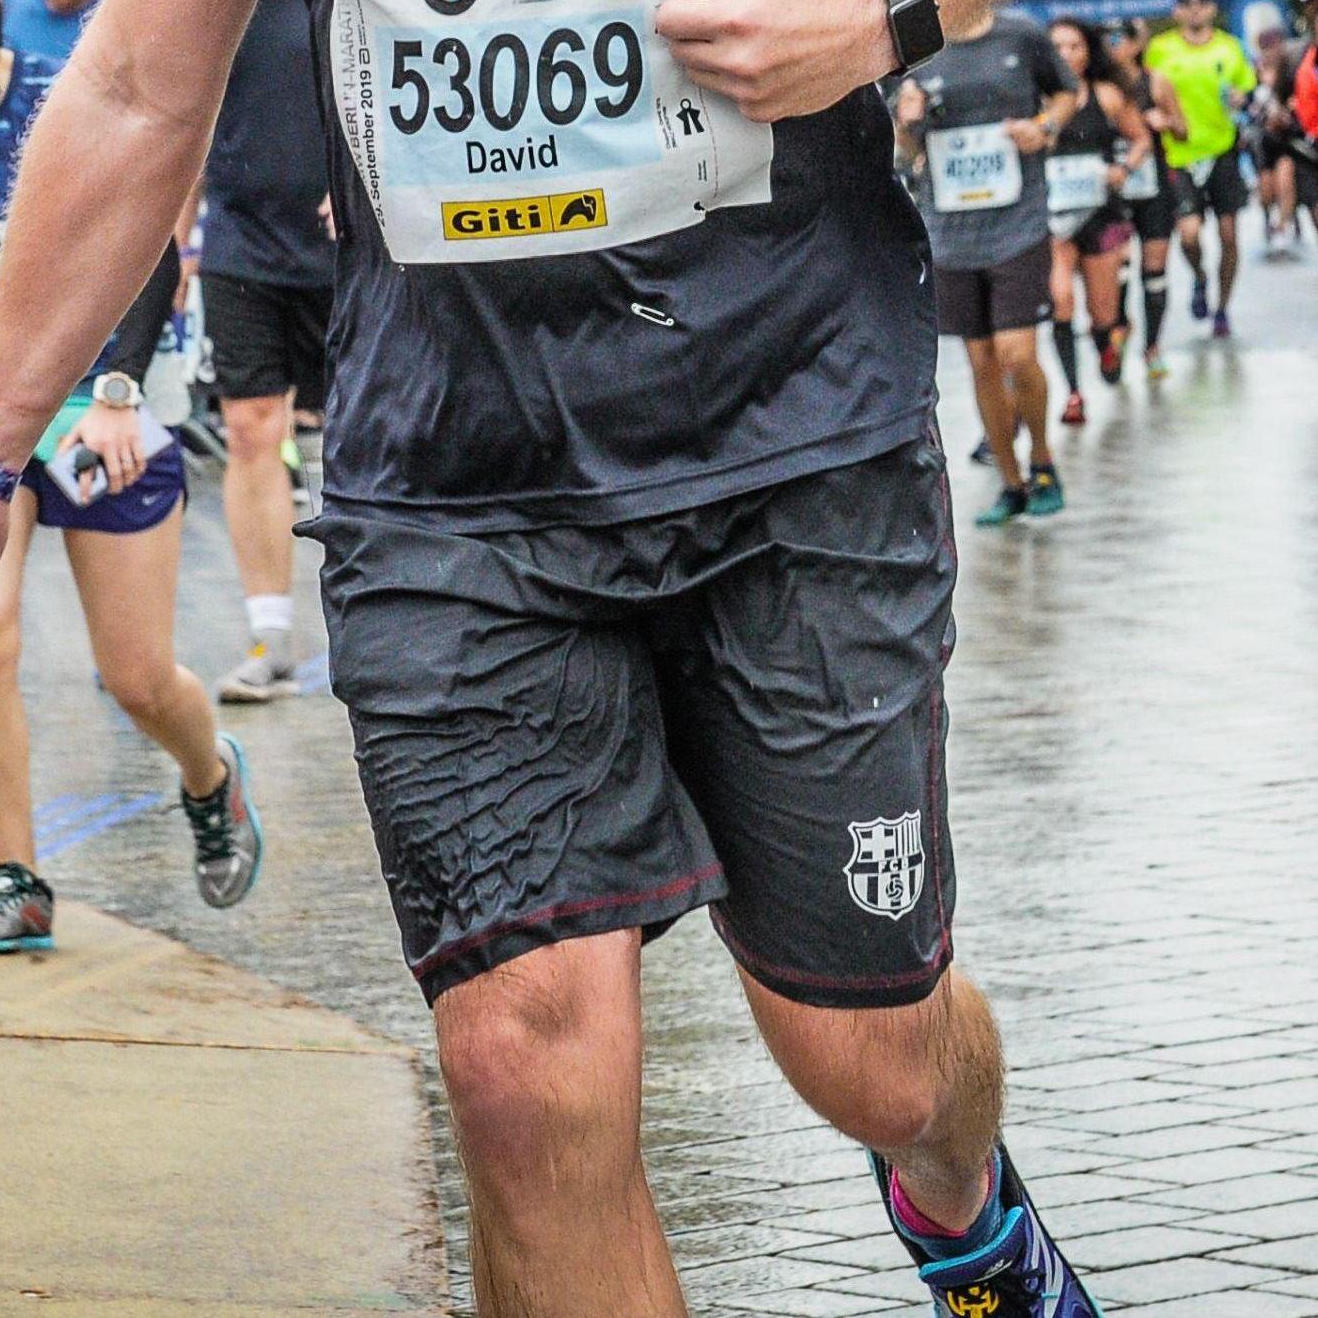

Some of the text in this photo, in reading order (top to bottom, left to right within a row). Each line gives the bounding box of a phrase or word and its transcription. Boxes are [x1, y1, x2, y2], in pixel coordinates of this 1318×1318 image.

[359, 70, 374, 110] 2019
[388, 21, 644, 136] 53069
[362, 113, 381, 201] September
[465, 135, 559, 174] David
[451, 204, 542, 236] Giti
